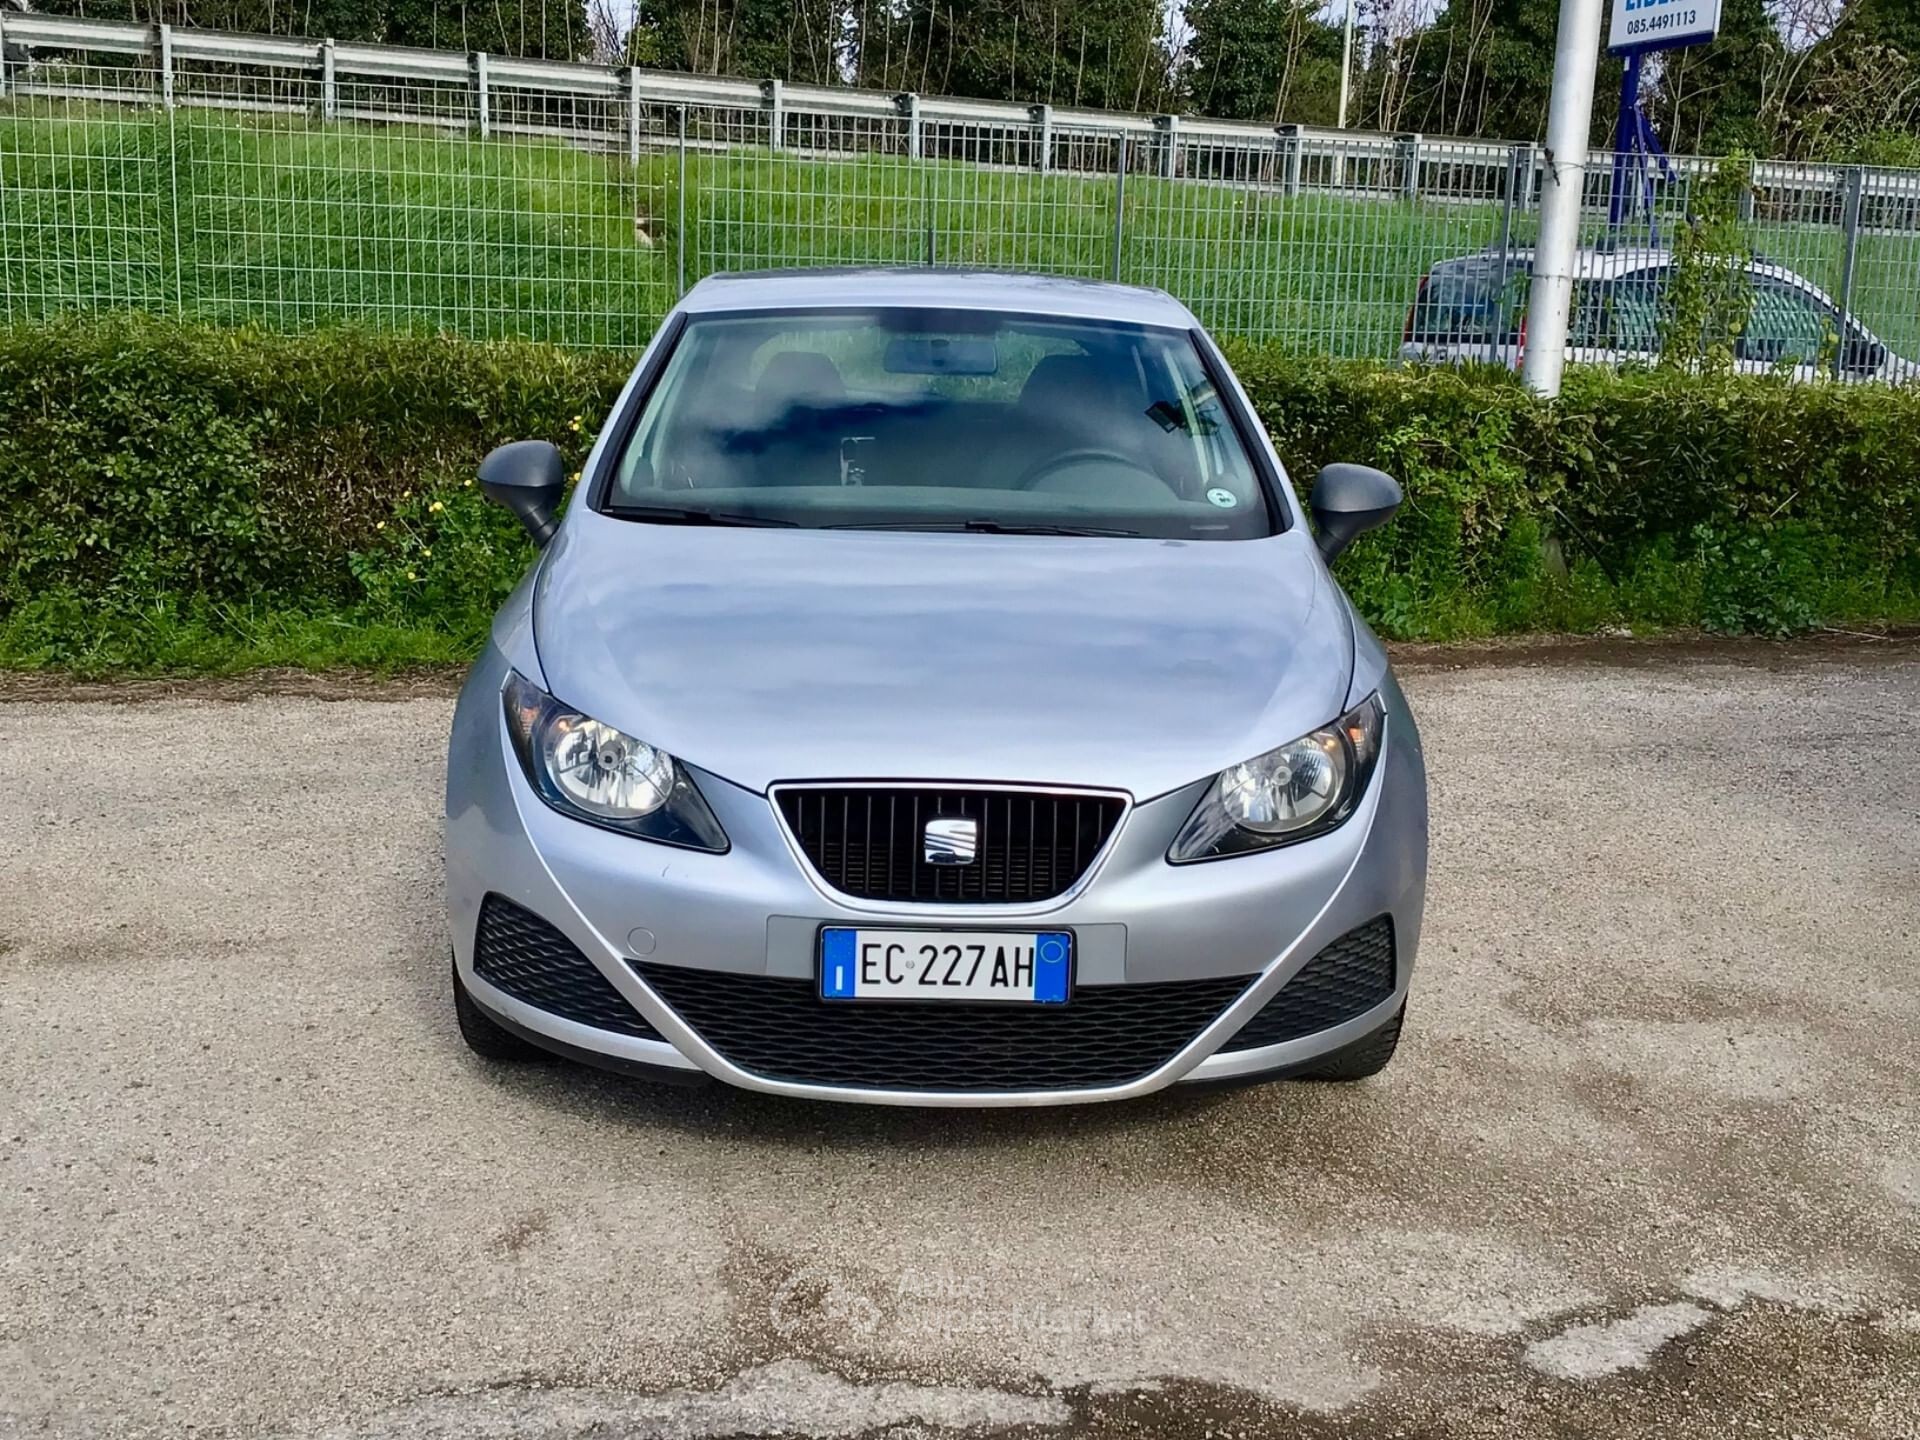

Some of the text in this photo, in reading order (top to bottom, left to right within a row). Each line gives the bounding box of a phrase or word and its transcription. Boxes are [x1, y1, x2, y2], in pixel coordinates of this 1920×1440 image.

[1627, 9, 1697, 35] 085.4491113
[861, 943, 905, 985] EC
[835, 965, 844, 991] I
